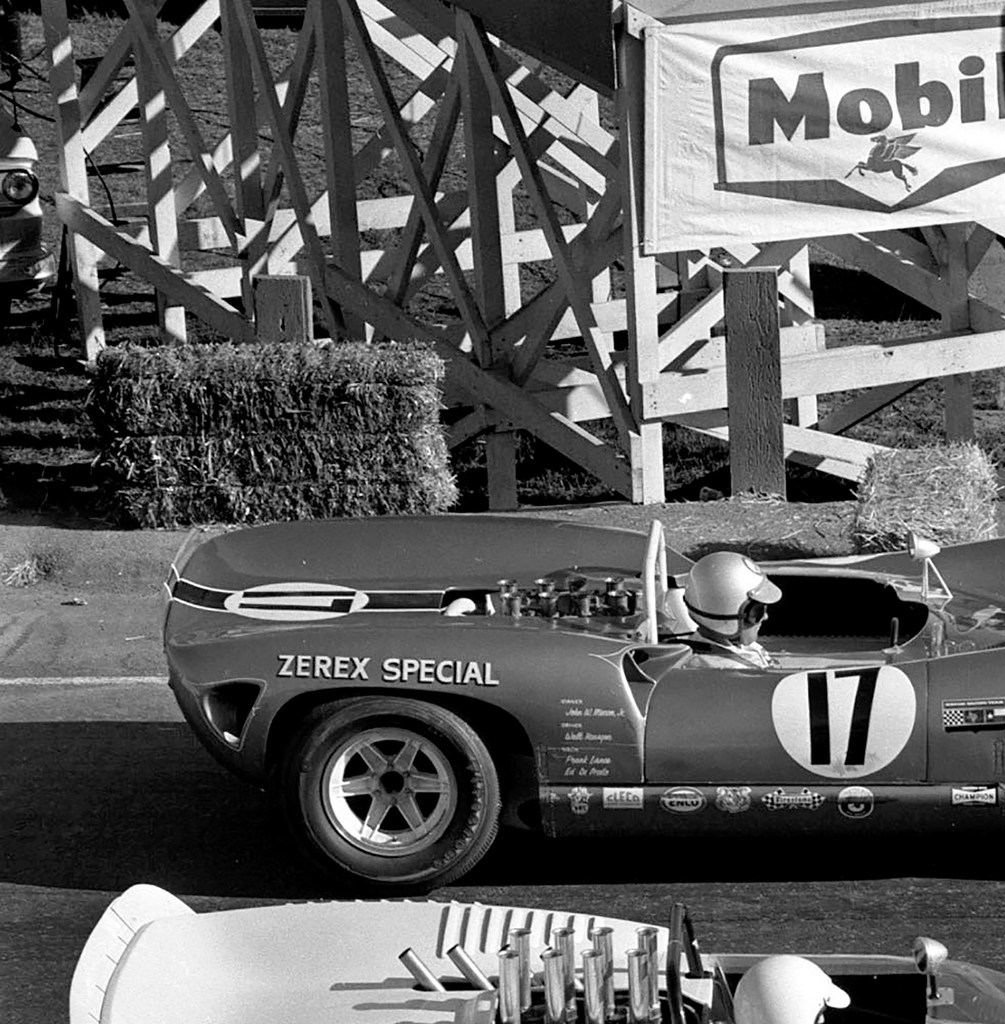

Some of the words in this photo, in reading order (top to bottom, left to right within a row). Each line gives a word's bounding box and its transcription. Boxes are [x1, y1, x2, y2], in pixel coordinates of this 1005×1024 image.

[277, 655, 371, 680] ZEREX
[381, 658, 499, 685] SPECIAL
[807, 667, 881, 765] 17
[954, 793, 994, 801] CHAMPION
